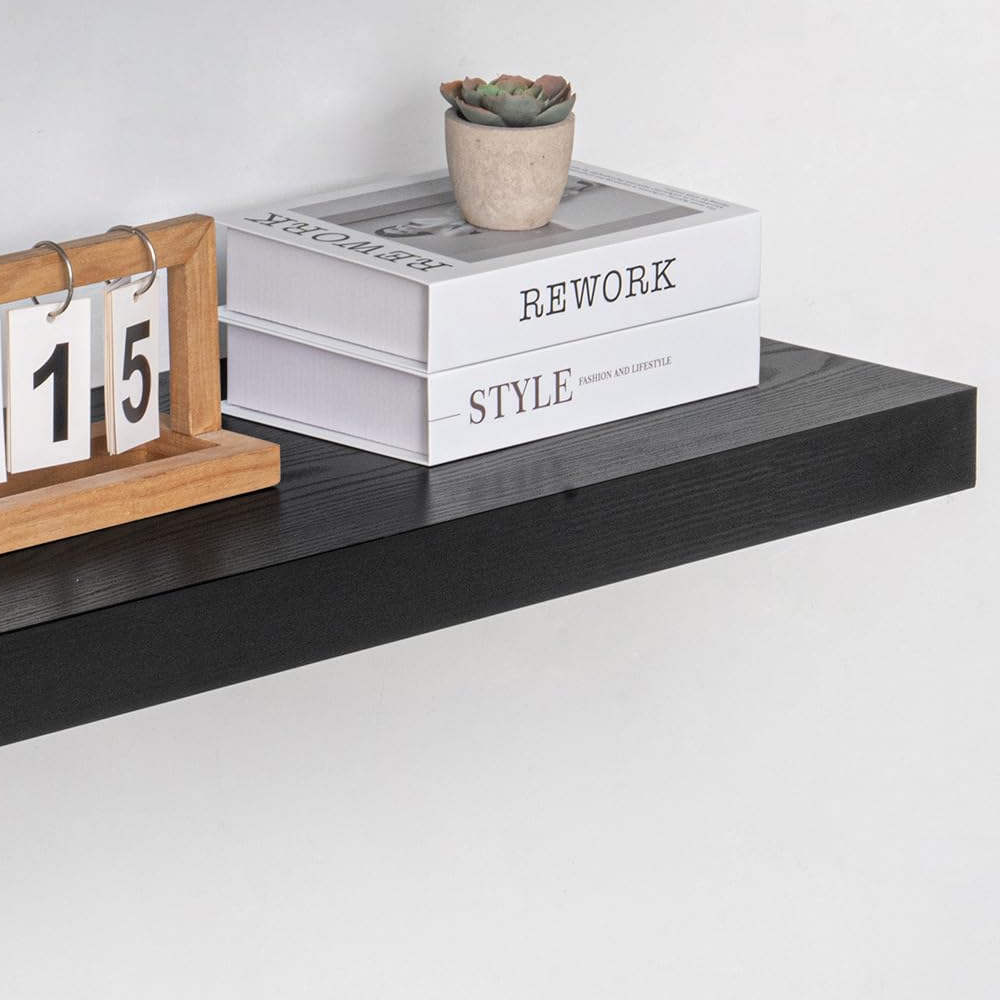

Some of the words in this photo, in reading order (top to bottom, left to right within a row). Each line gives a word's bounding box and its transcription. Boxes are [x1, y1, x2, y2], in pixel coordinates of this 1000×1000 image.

[244, 212, 453, 272] REWORK
[519, 257, 677, 322] REWORK
[469, 368, 573, 425] STYLE
[578, 370, 612, 386] FASHION
[613, 366, 631, 377] AND
[632, 356, 672, 373] LIFESTYLE
